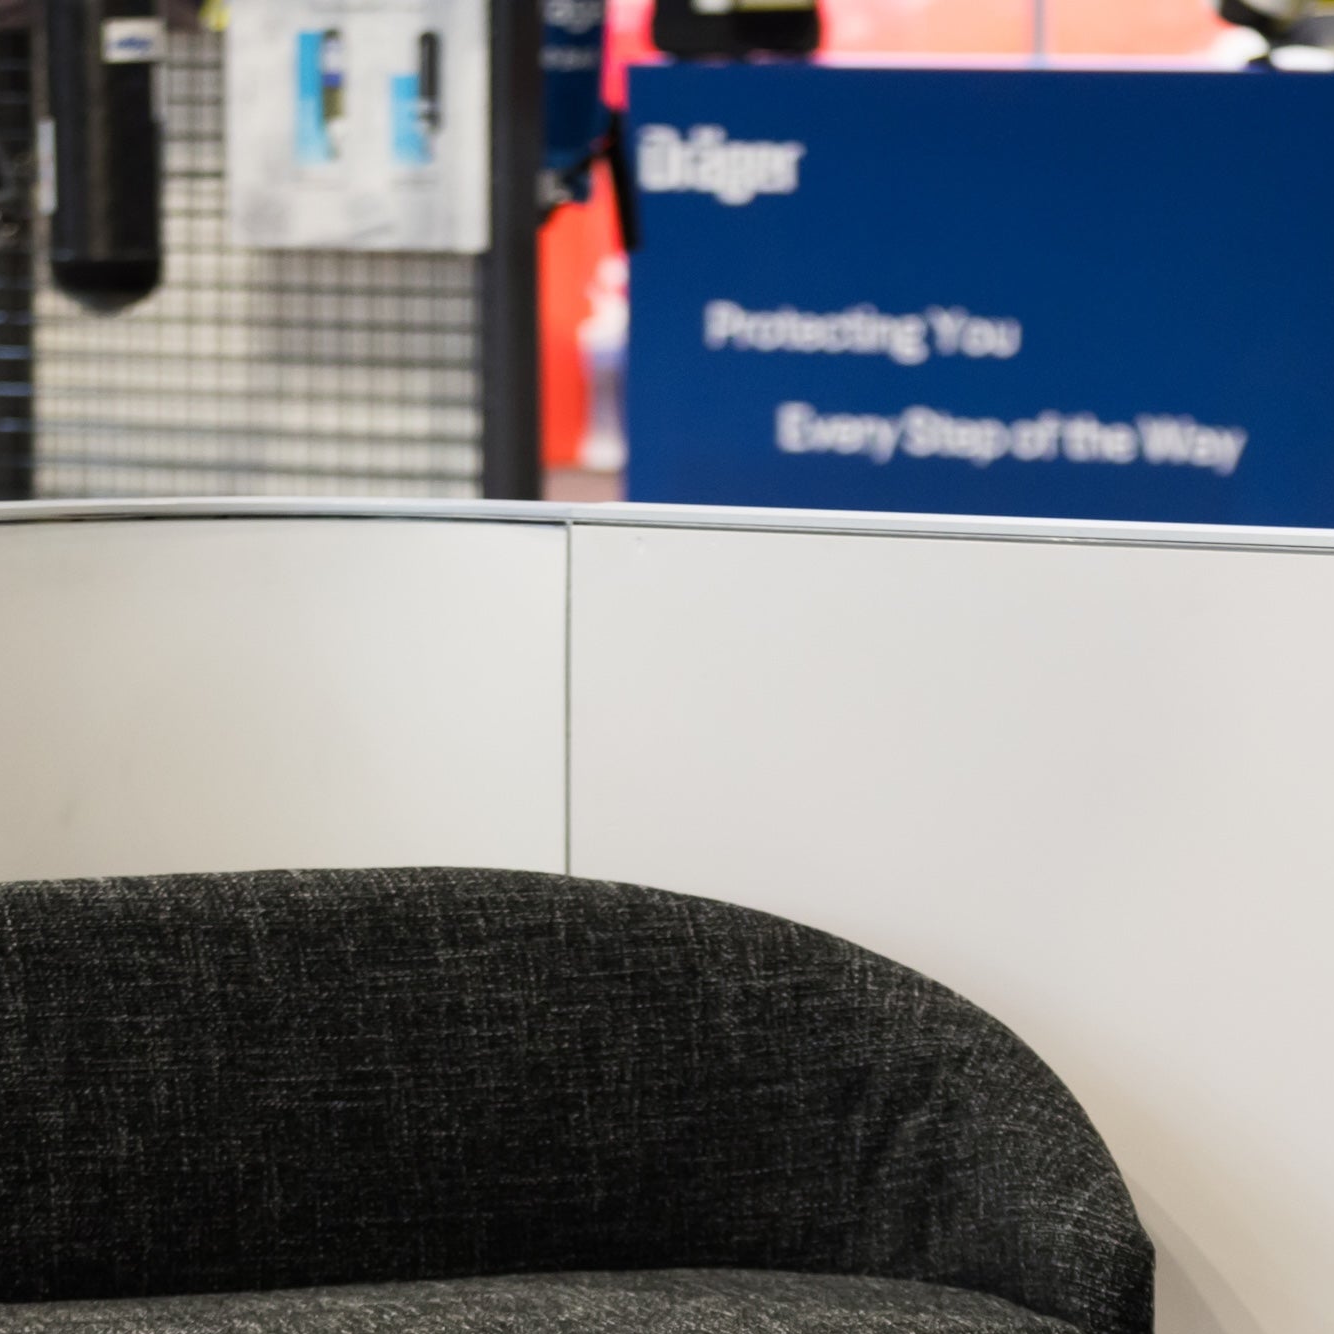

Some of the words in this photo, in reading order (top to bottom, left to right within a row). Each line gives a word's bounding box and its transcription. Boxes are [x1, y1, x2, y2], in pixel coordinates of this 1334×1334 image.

[704, 299, 929, 366] Protecting
[928, 305, 1022, 358] You
[776, 401, 901, 465] Every
[901, 405, 1009, 467] Step
[1010, 410, 1062, 460] of
[1064, 411, 1137, 463] the
[1137, 413, 1247, 476] Way
